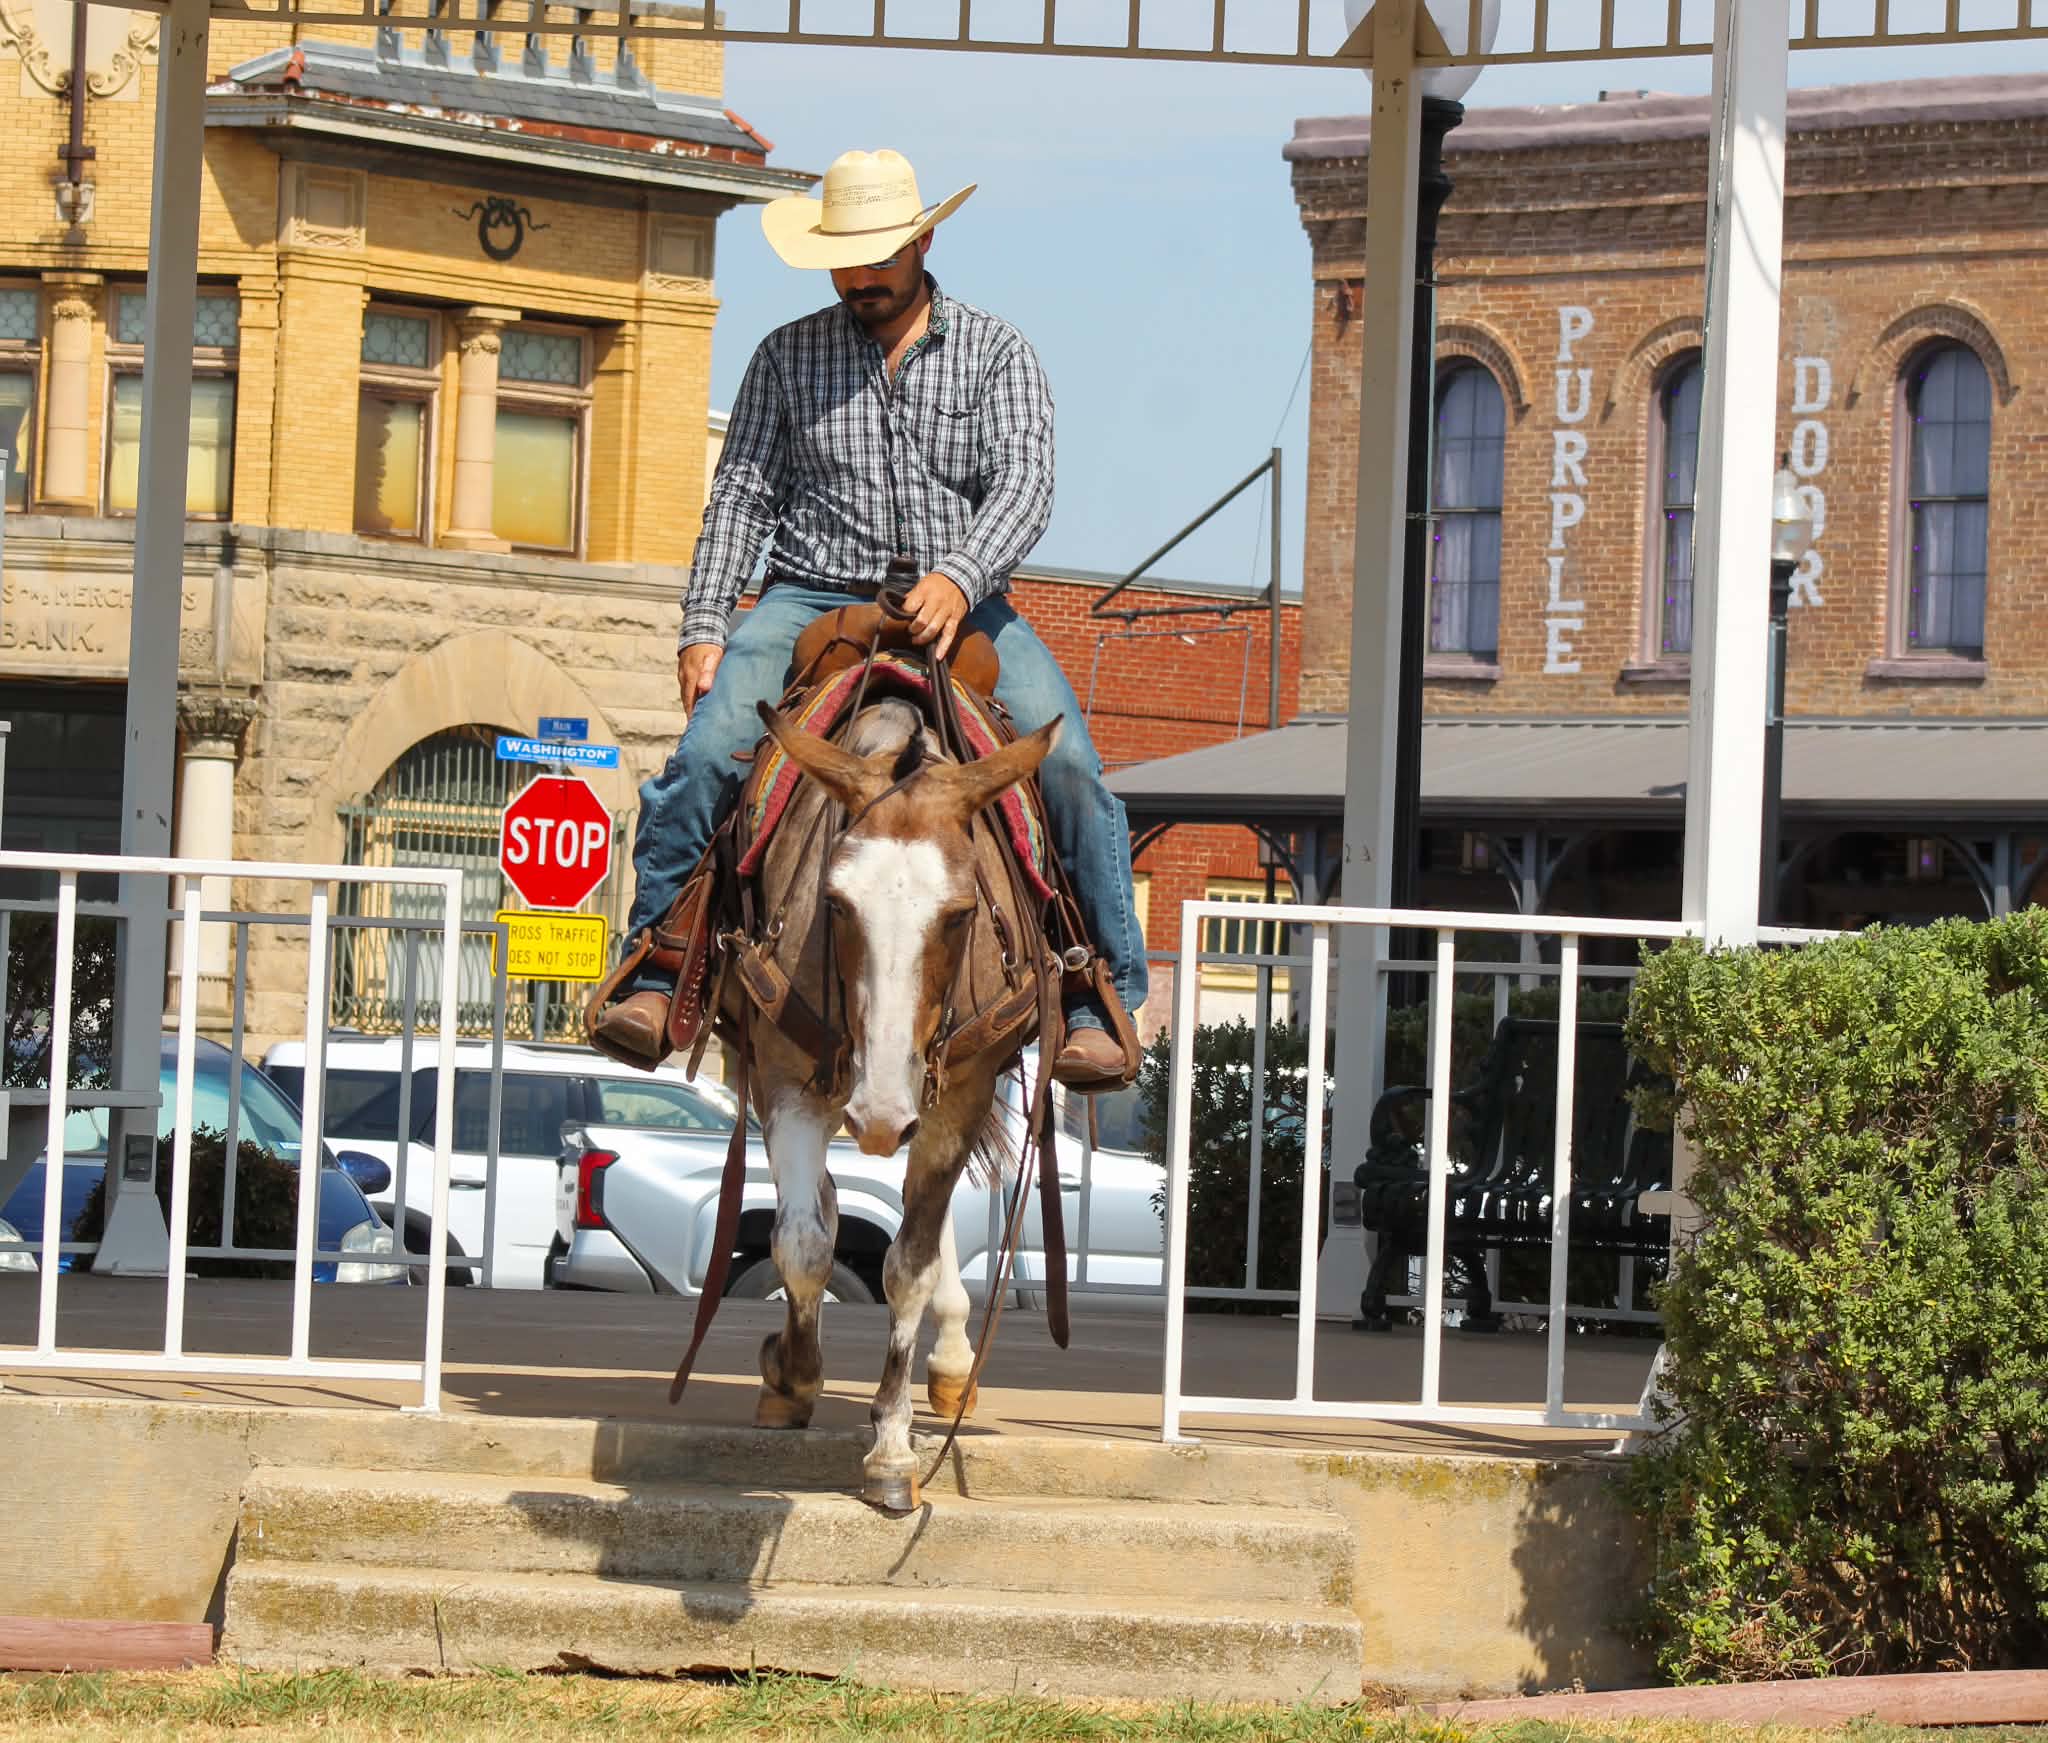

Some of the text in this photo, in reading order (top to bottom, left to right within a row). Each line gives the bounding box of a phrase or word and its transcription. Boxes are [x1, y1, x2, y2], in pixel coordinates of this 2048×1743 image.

[1543, 305, 1594, 674] PURPLE
[506, 816, 607, 869] STOP
[511, 925, 598, 943] ROSS TRAFFIC
[509, 949, 597, 968] OES NOT STOP
